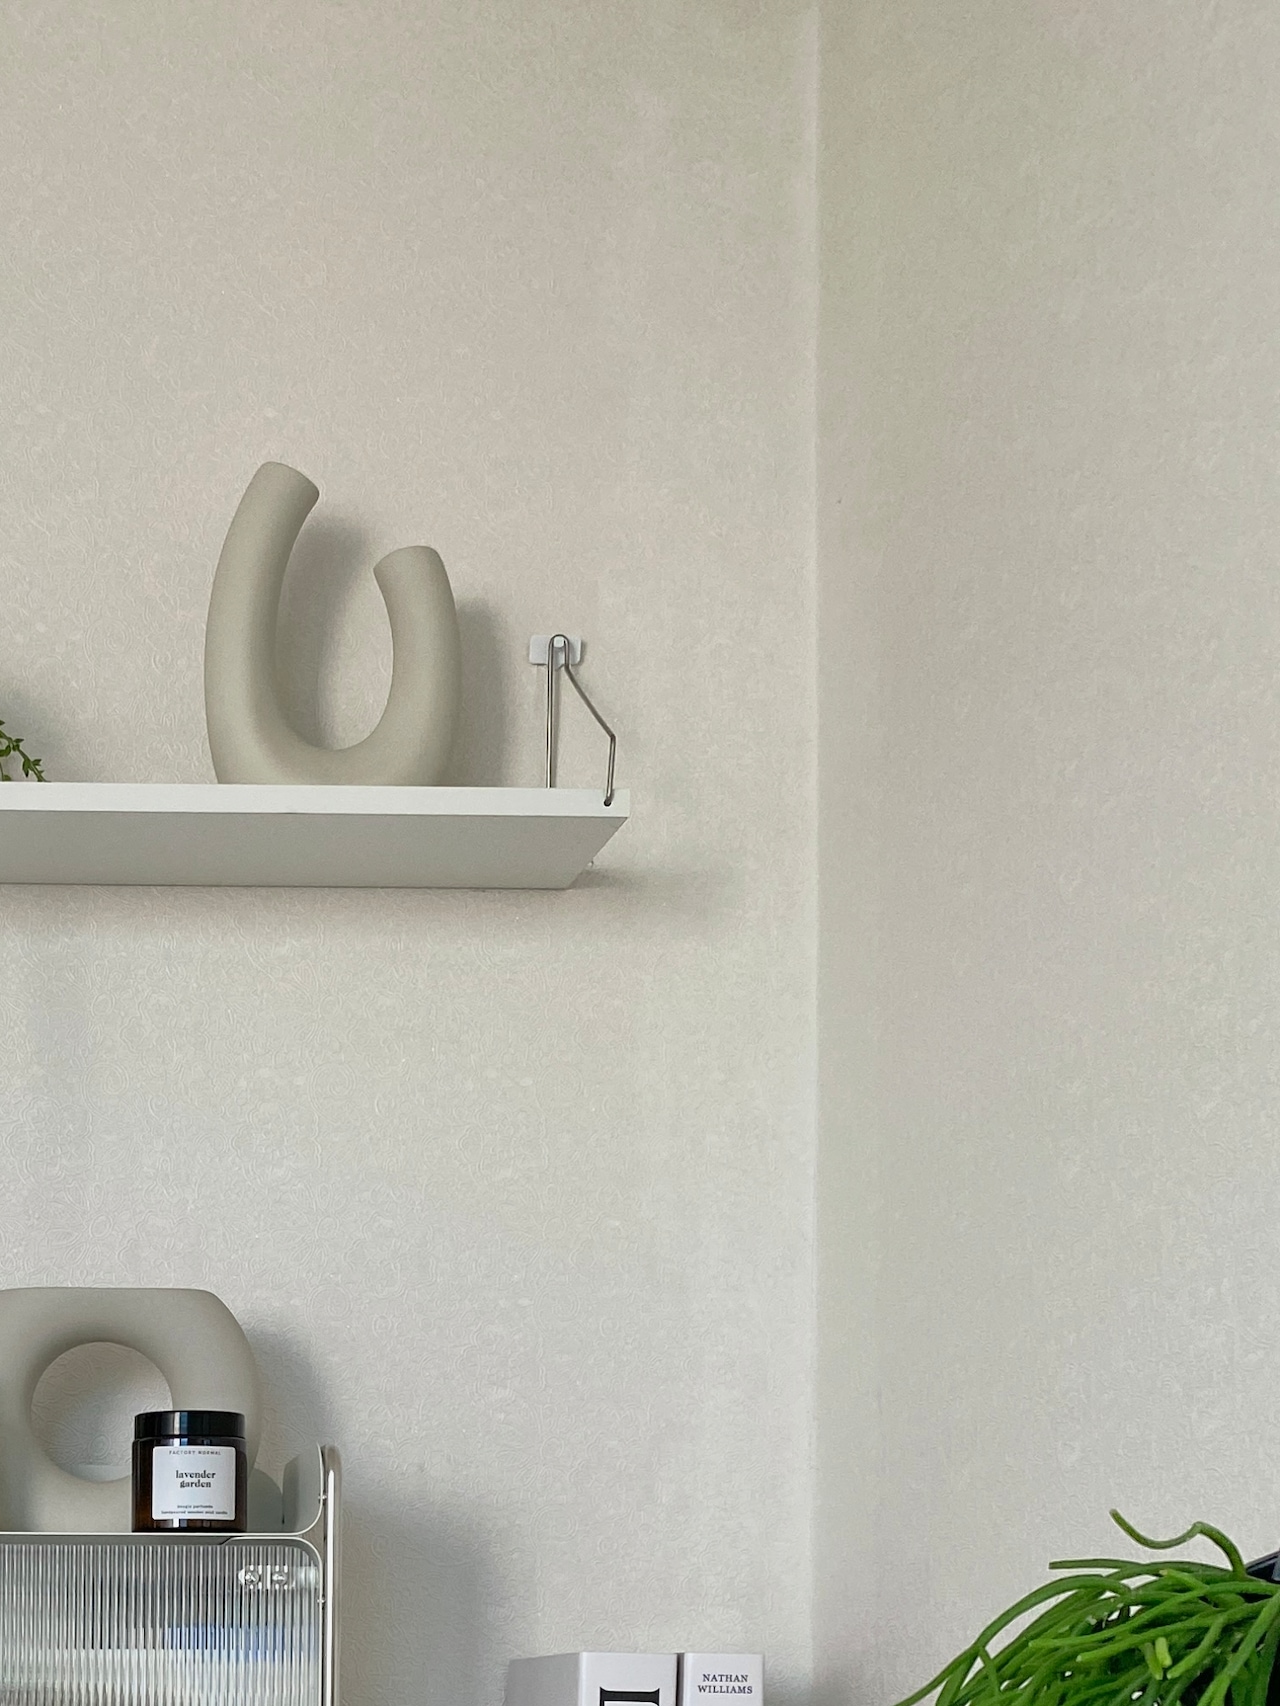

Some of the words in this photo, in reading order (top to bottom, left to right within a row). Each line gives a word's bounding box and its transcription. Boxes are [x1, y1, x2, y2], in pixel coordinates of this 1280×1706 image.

[175, 1470, 217, 1479] lavender
[179, 1479, 212, 1489] garden
[702, 1673, 749, 1683] NATHAN
[698, 1684, 753, 1694] WILLIAMS
